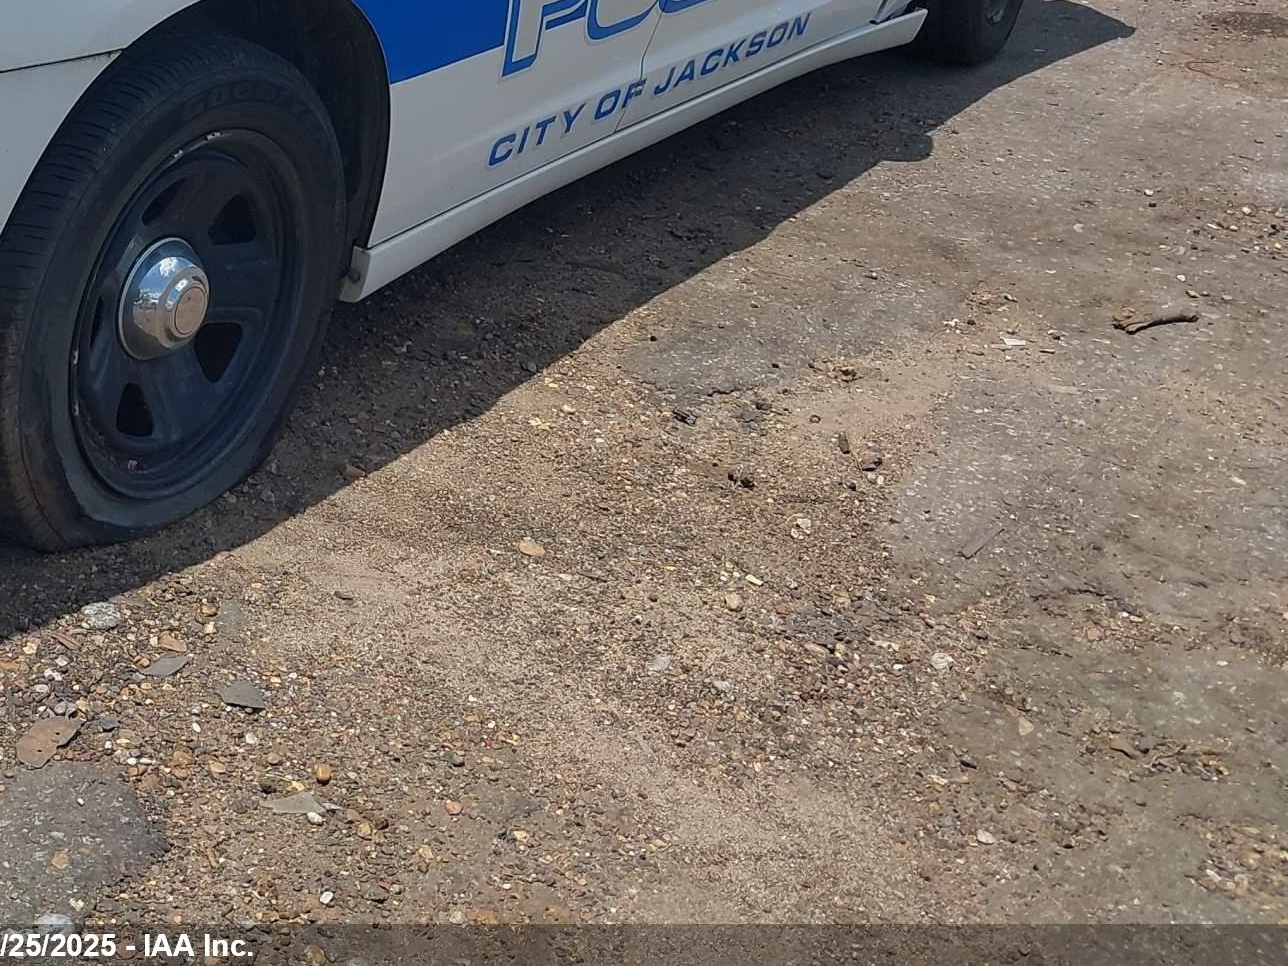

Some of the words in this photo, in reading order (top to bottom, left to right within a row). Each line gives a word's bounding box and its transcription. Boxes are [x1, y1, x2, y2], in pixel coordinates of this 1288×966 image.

[487, 103, 586, 167] CITY
[593, 78, 647, 122] OF
[653, 11, 813, 98] JACKSON
